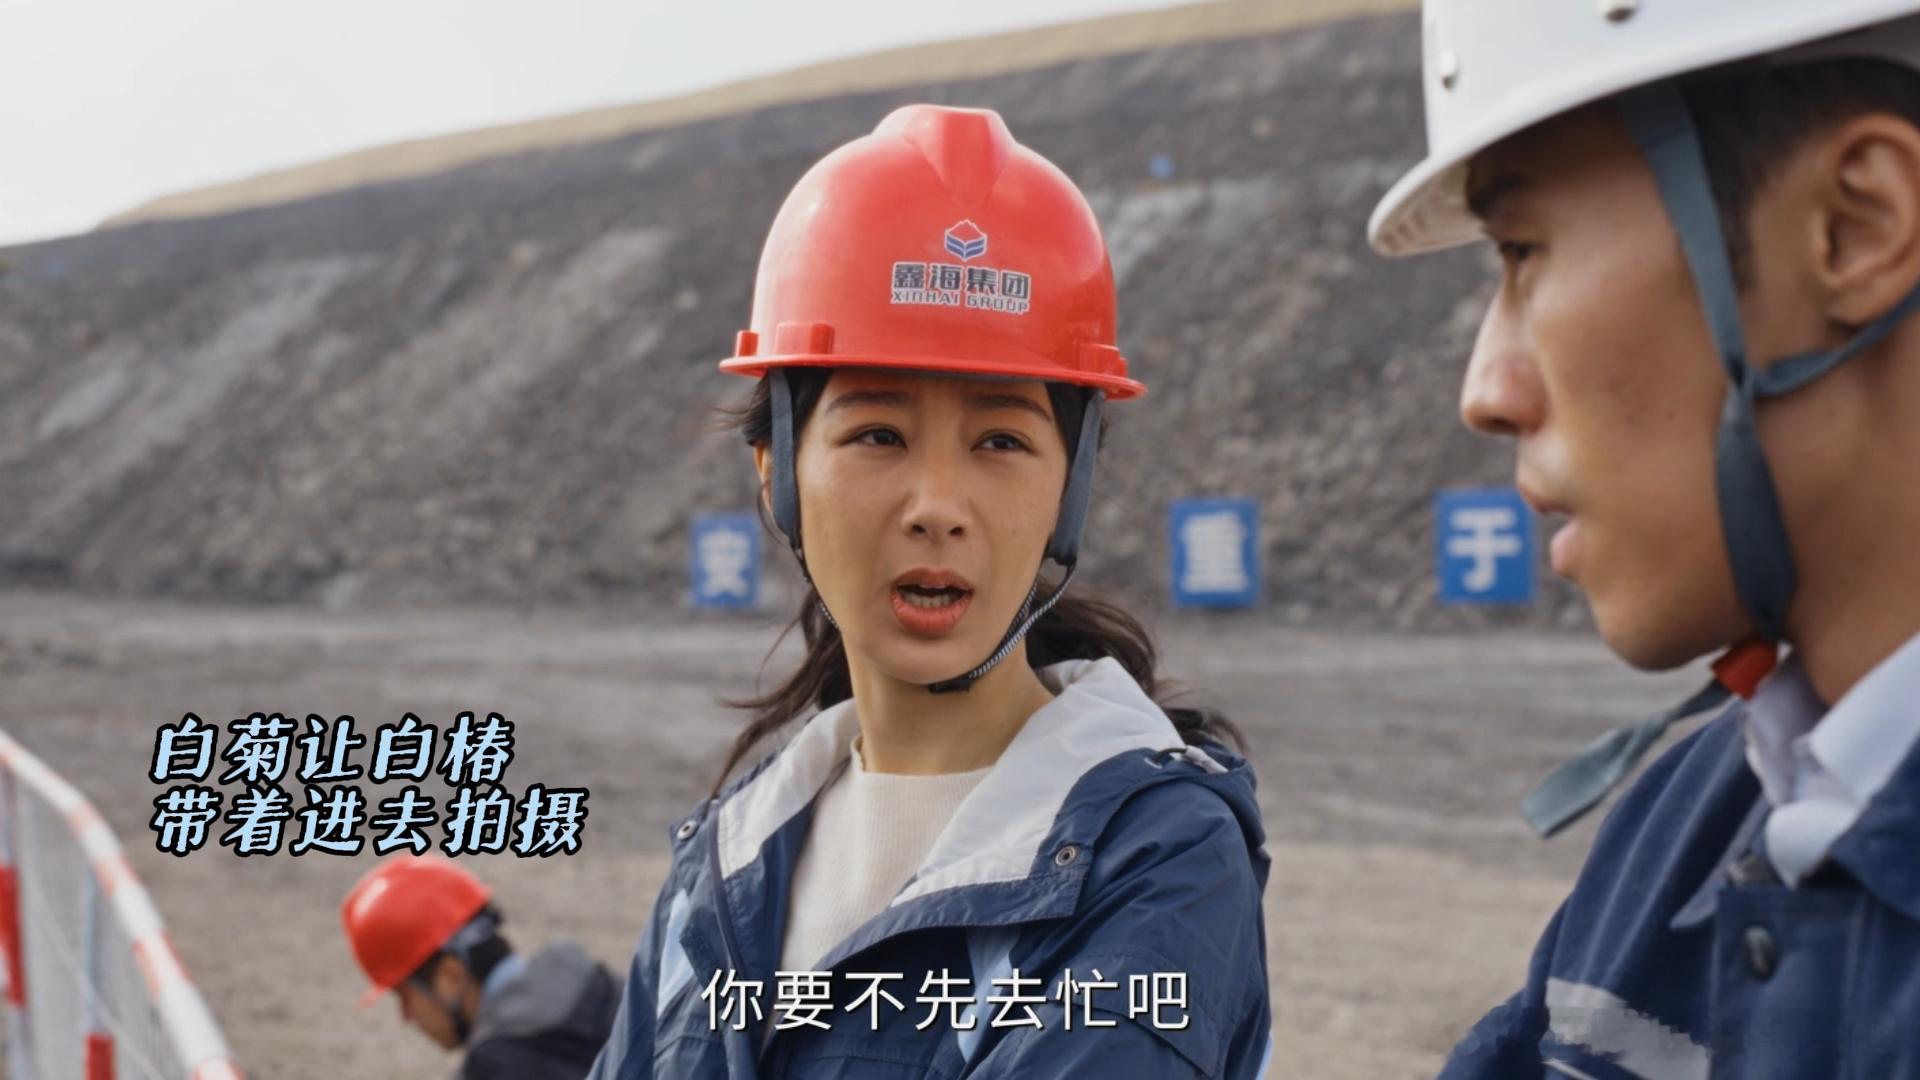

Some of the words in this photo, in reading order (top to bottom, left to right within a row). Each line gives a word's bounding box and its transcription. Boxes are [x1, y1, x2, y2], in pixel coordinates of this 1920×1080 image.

[893, 263, 1030, 299] 鑫海集团
[967, 295, 1028, 312] GROUP
[1179, 510, 1249, 593] 重
[1446, 507, 1522, 592] 于
